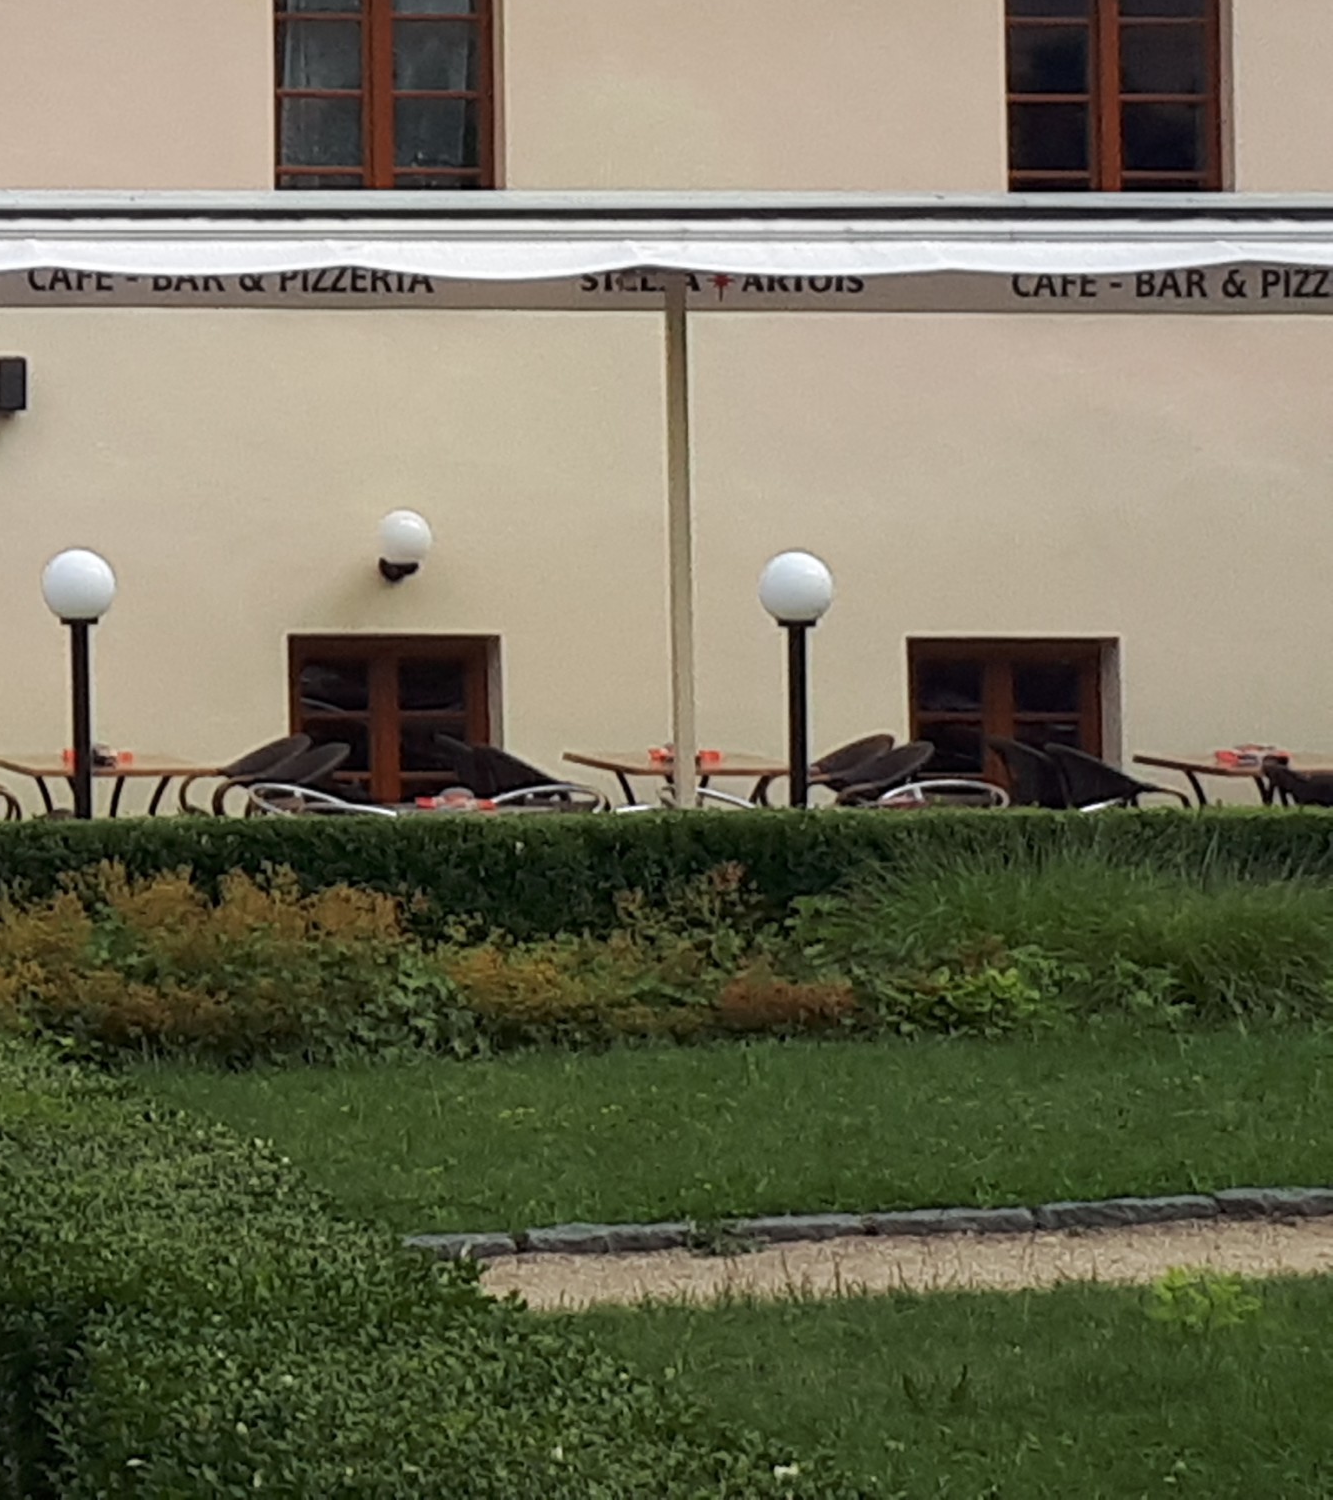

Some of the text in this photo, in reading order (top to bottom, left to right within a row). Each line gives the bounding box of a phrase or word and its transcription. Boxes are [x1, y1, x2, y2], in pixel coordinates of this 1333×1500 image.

[279, 266, 435, 293] PIZZERIA
[741, 273, 865, 293] ARTOIS
[1135, 269, 1208, 298] BAR
[1221, 269, 1247, 299] &
